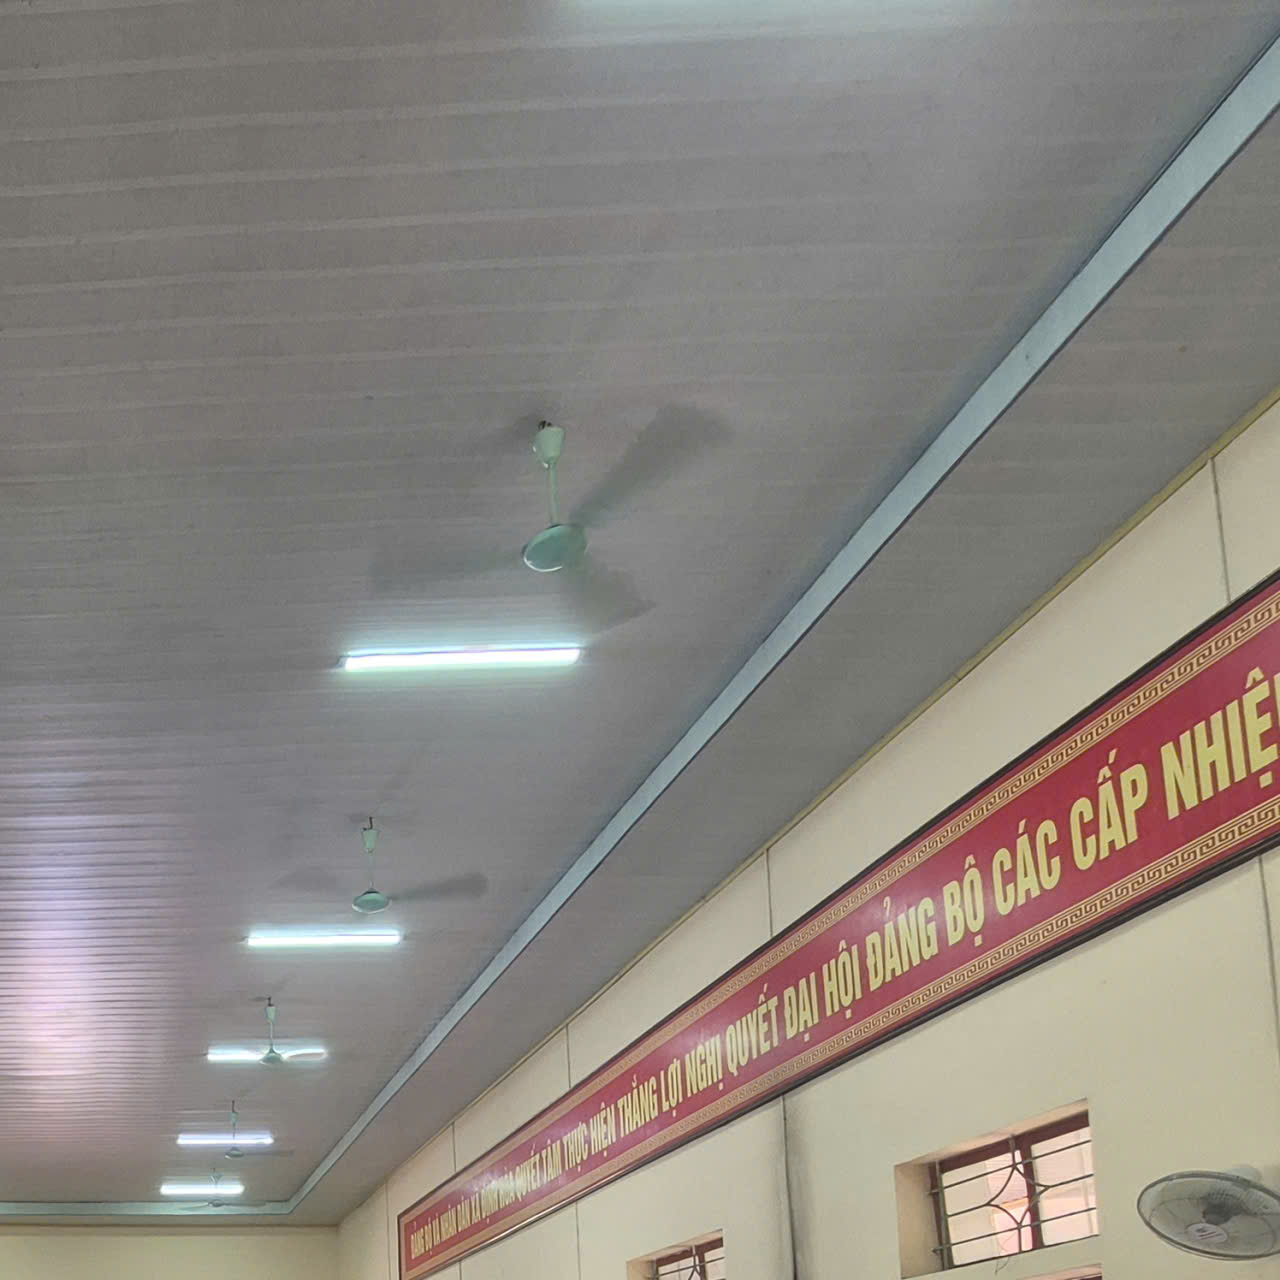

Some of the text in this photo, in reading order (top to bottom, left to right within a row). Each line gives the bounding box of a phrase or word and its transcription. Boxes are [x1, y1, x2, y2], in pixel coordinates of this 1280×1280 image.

[562, 1121, 588, 1172] THỰC
[590, 1101, 616, 1158] HIỆN
[617, 1074, 658, 1138] THẮNG
[660, 1057, 684, 1117] LỢI
[684, 1034, 723, 1090] NGHỊ
[725, 983, 779, 1076] QUYẾT
[783, 971, 820, 1042] ĐẠI
[823, 939, 862, 1019] HỘI
[866, 896, 939, 991] ĐẢNG
[943, 855, 985, 947] BỘ
[992, 819, 1061, 916] CÁC
[1070, 748, 1149, 870] CẤP
